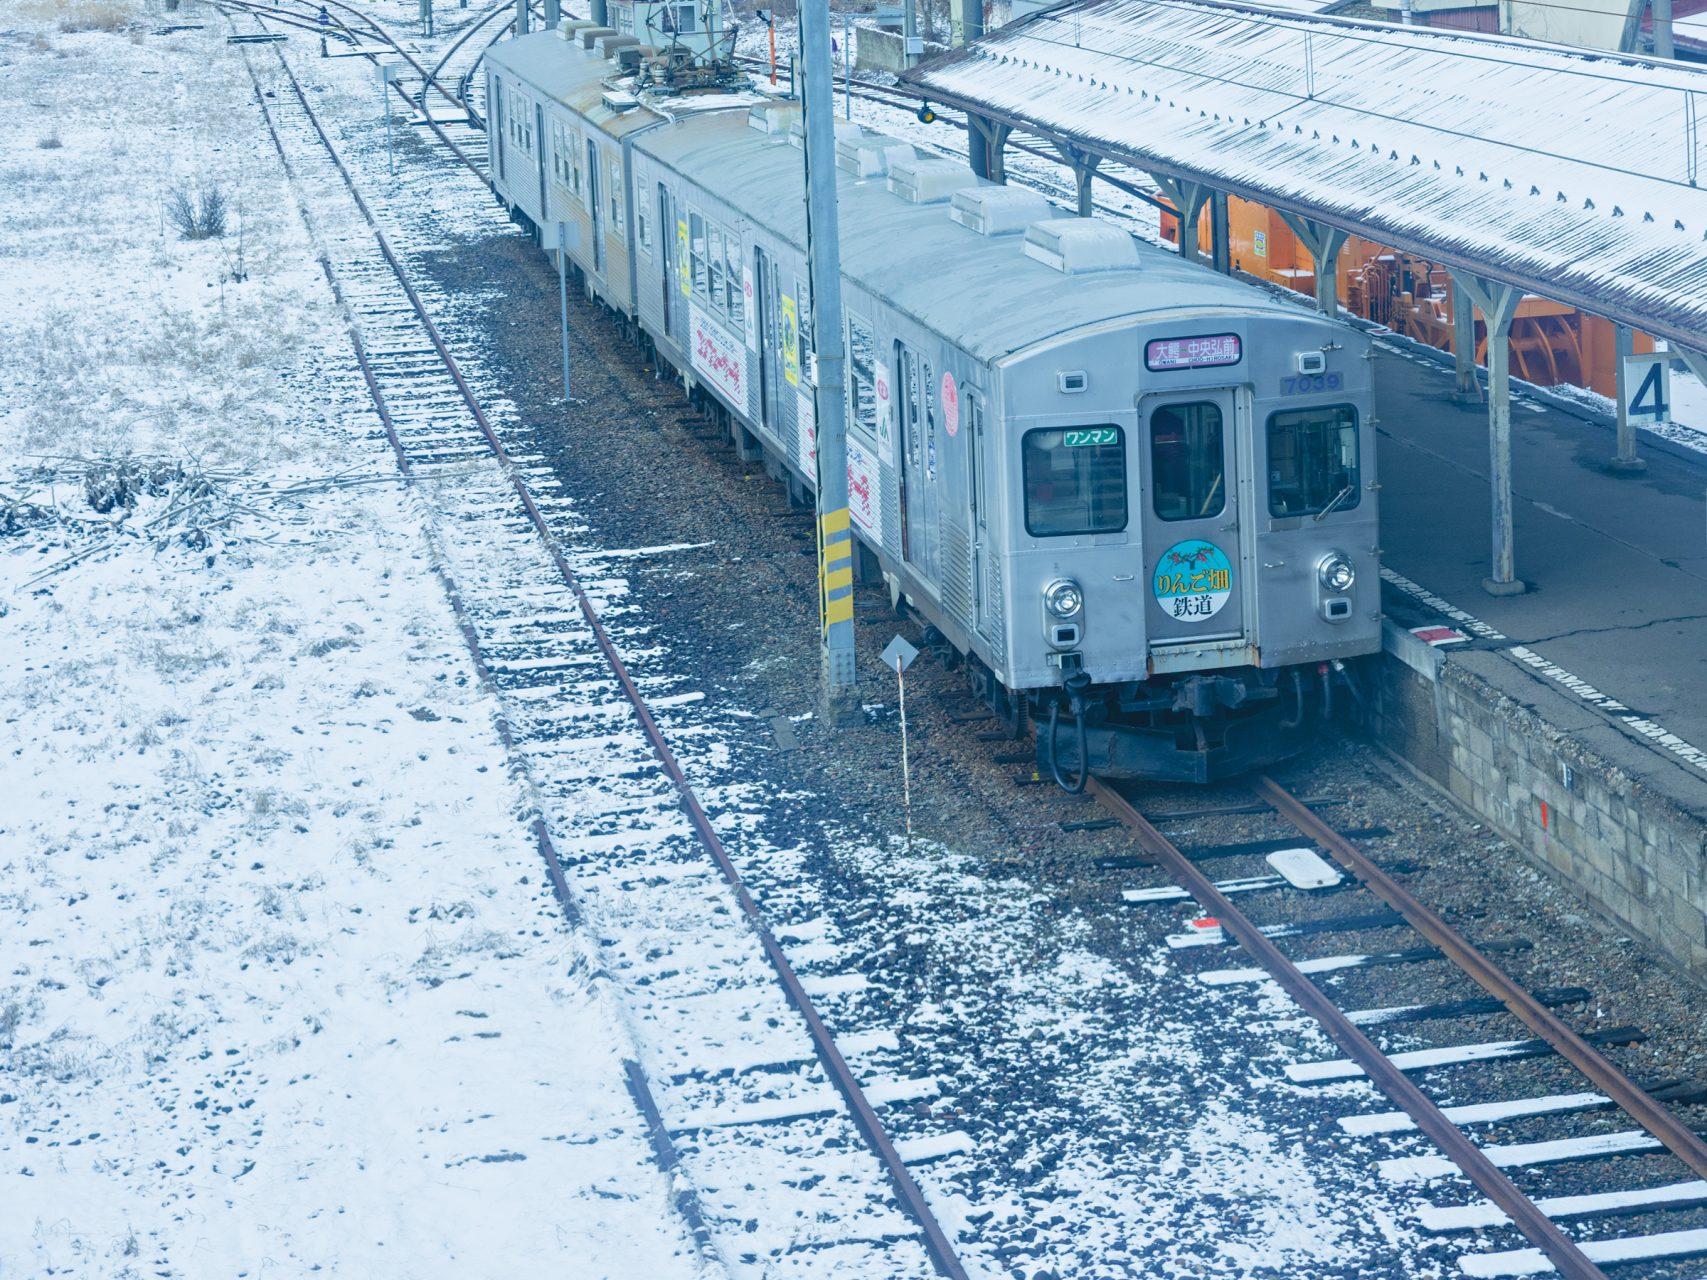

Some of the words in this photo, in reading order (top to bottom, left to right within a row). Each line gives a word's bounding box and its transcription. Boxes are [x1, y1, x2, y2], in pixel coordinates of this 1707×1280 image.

[1188, 338, 1235, 357] 中央弘前
[1285, 374, 1340, 394] 7039
[1629, 362, 1669, 422] 4
[1066, 429, 1115, 445] ワンマン
[1157, 568, 1230, 595] りんご畑
[1173, 594, 1213, 617] 鉄道
